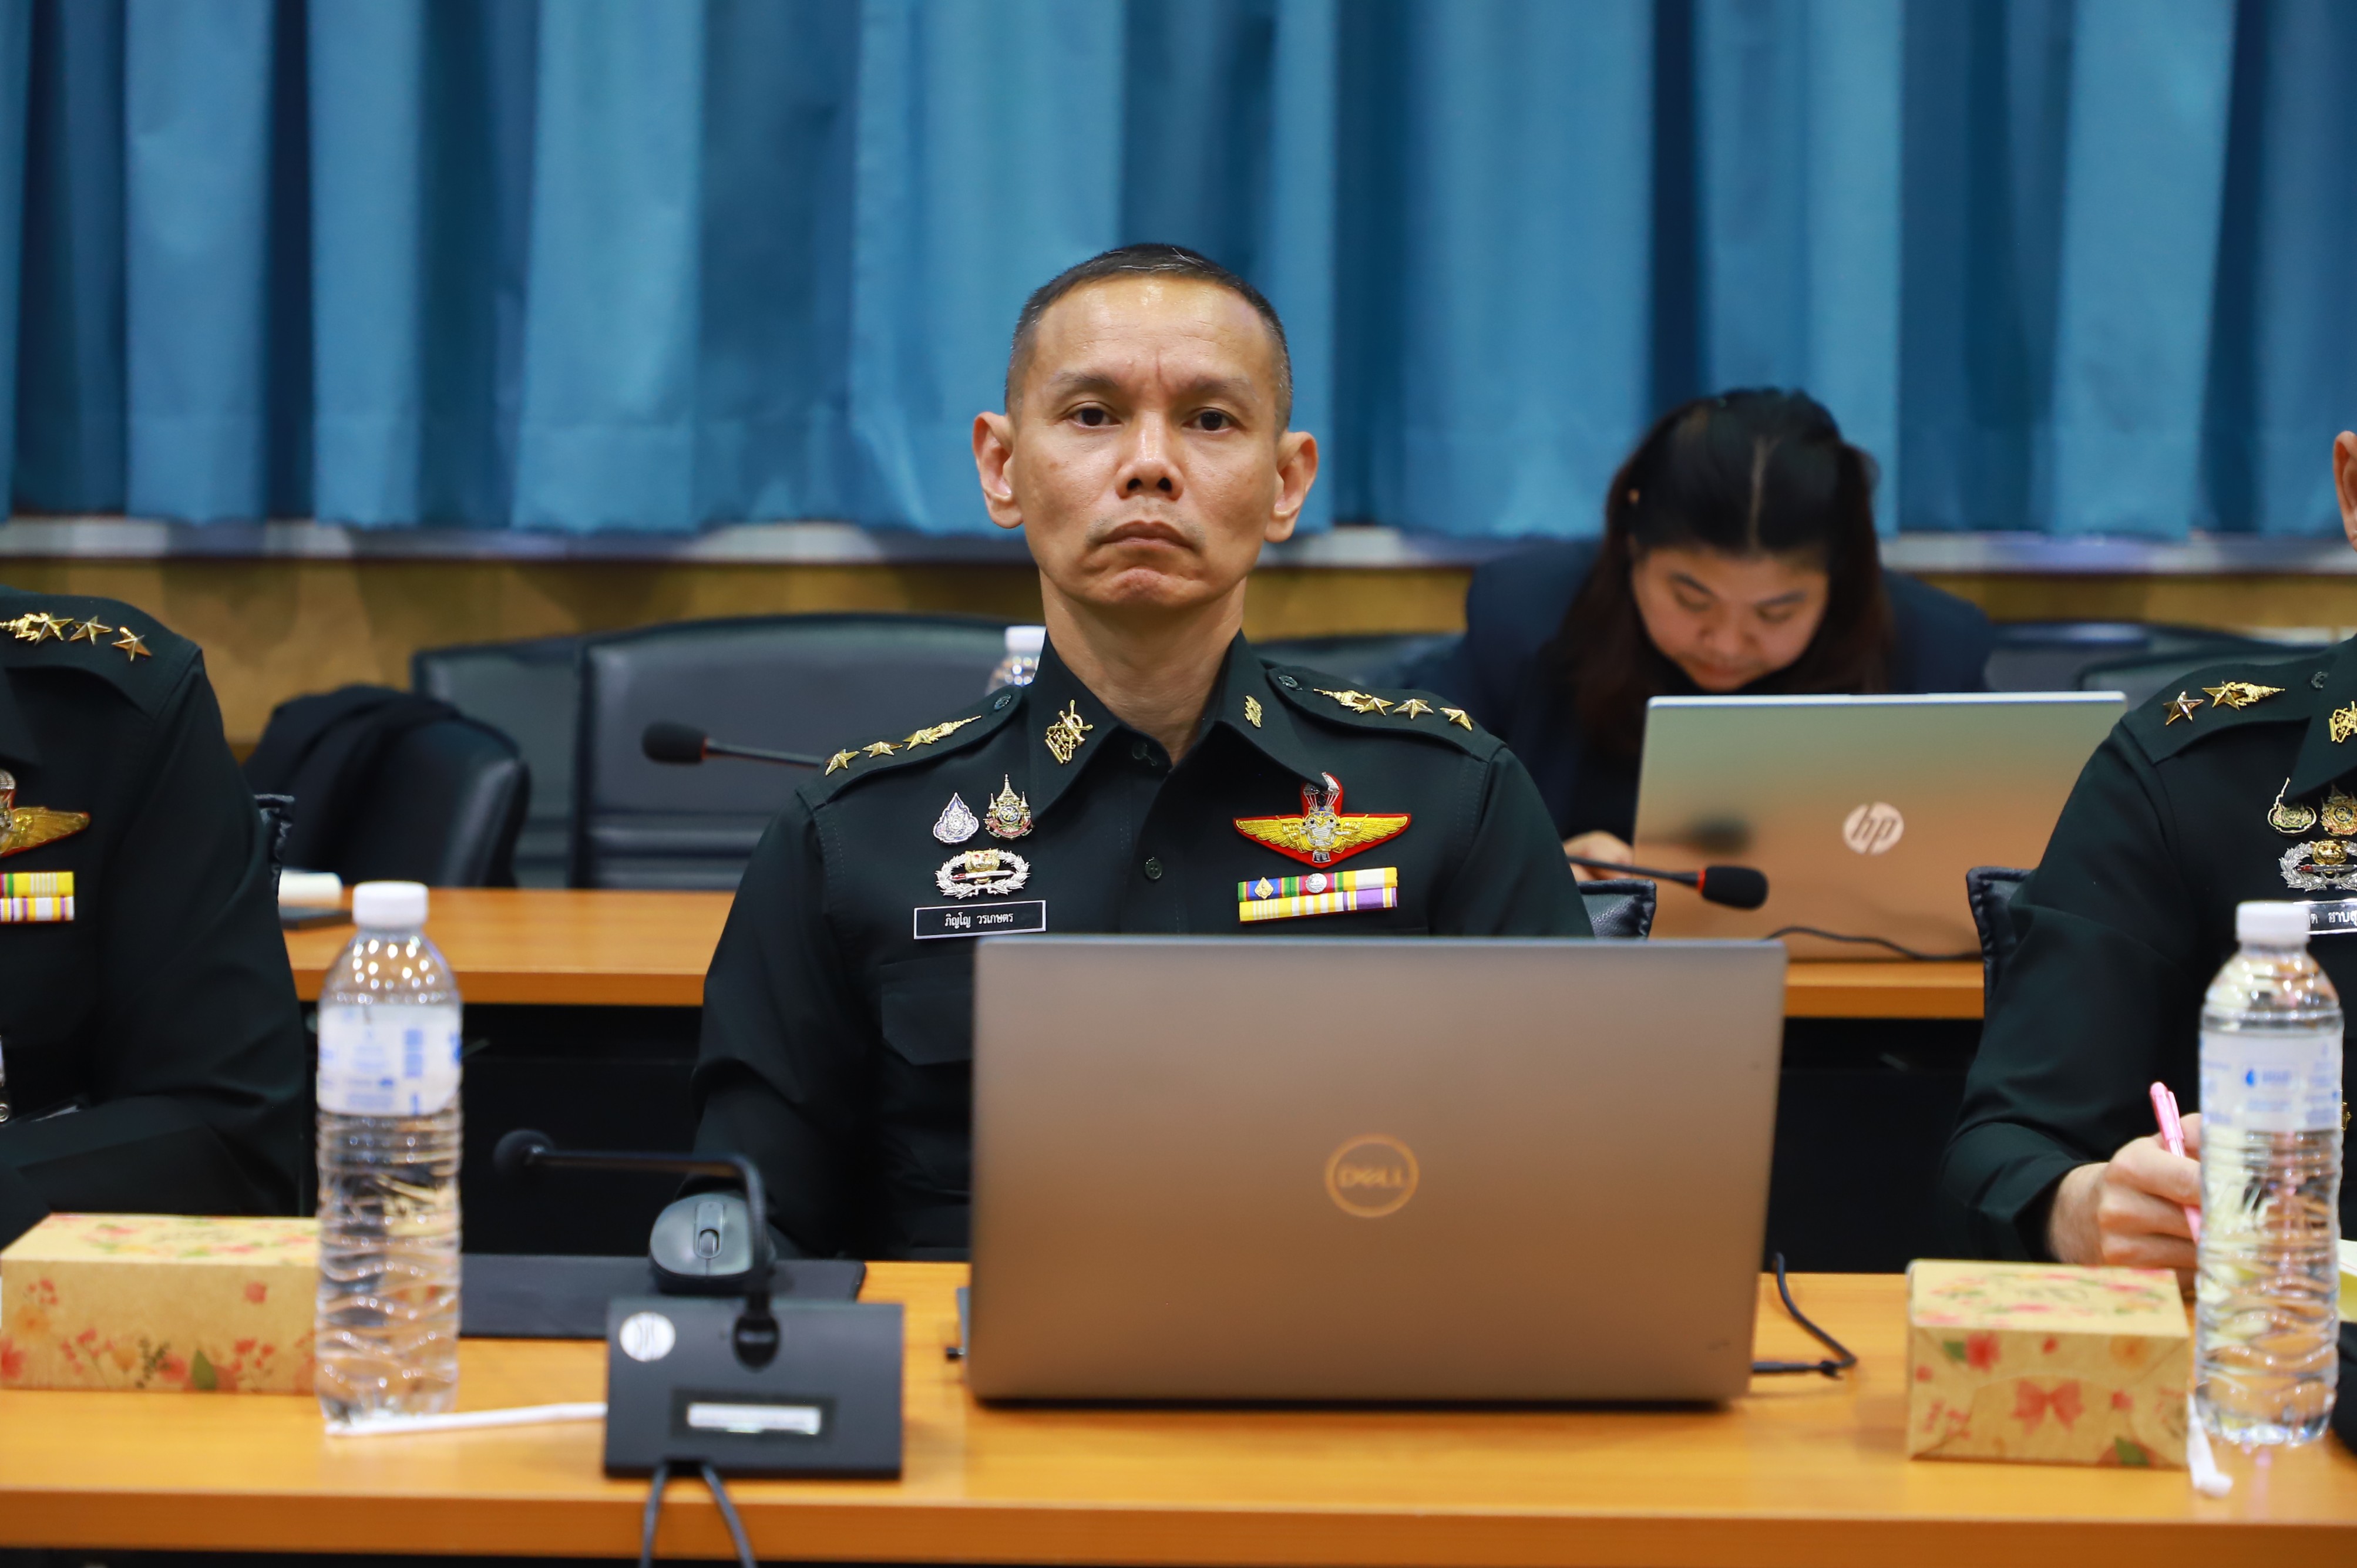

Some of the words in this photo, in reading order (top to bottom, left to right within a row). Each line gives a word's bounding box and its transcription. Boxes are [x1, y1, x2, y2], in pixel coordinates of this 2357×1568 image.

[1844, 802, 1902, 856] hp
[944, 912, 971, 928] ภิญโญ
[977, 913, 1014, 924] วรเกษตร
[1339, 1166, 1403, 1187] DELL
